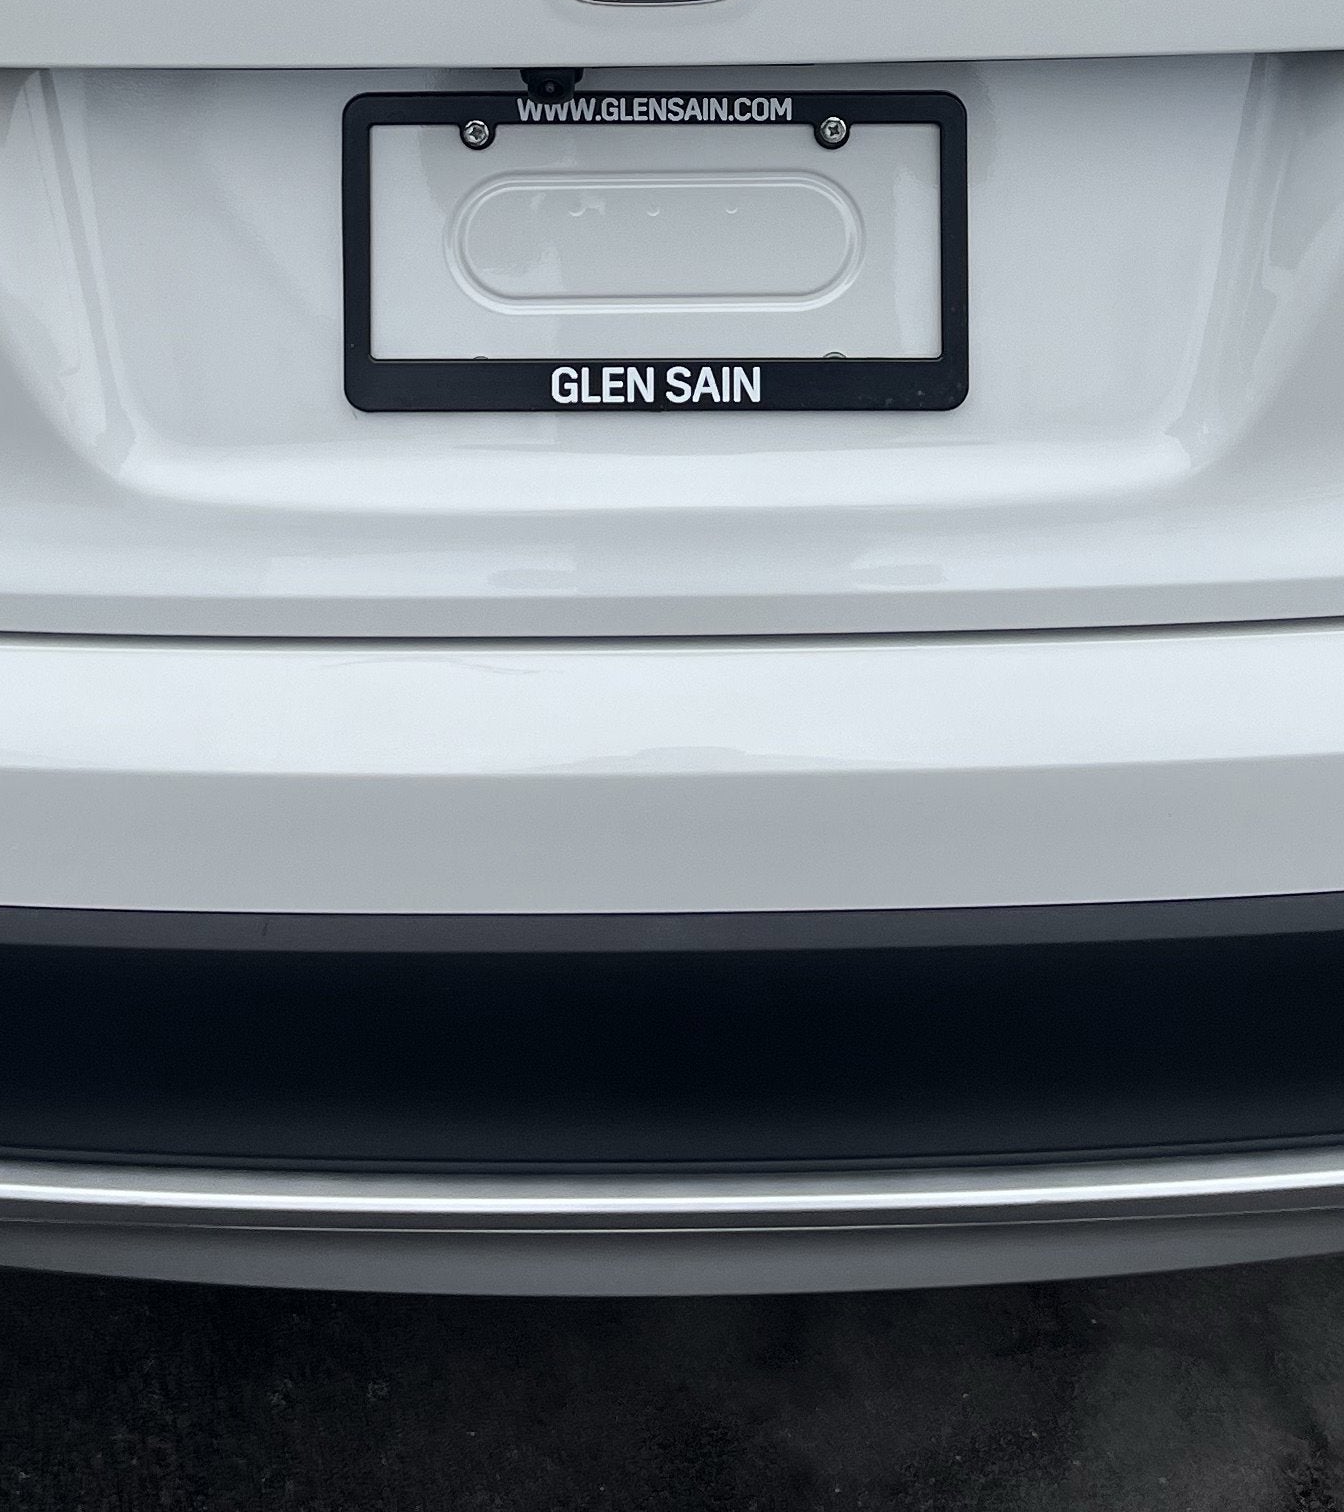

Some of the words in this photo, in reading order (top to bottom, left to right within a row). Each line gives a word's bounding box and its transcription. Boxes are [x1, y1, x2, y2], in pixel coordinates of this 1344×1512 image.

[516, 96, 793, 122] WWW.GLENSAIN.COM
[551, 366, 654, 405] GLEN
[665, 365, 762, 405] SAIN
